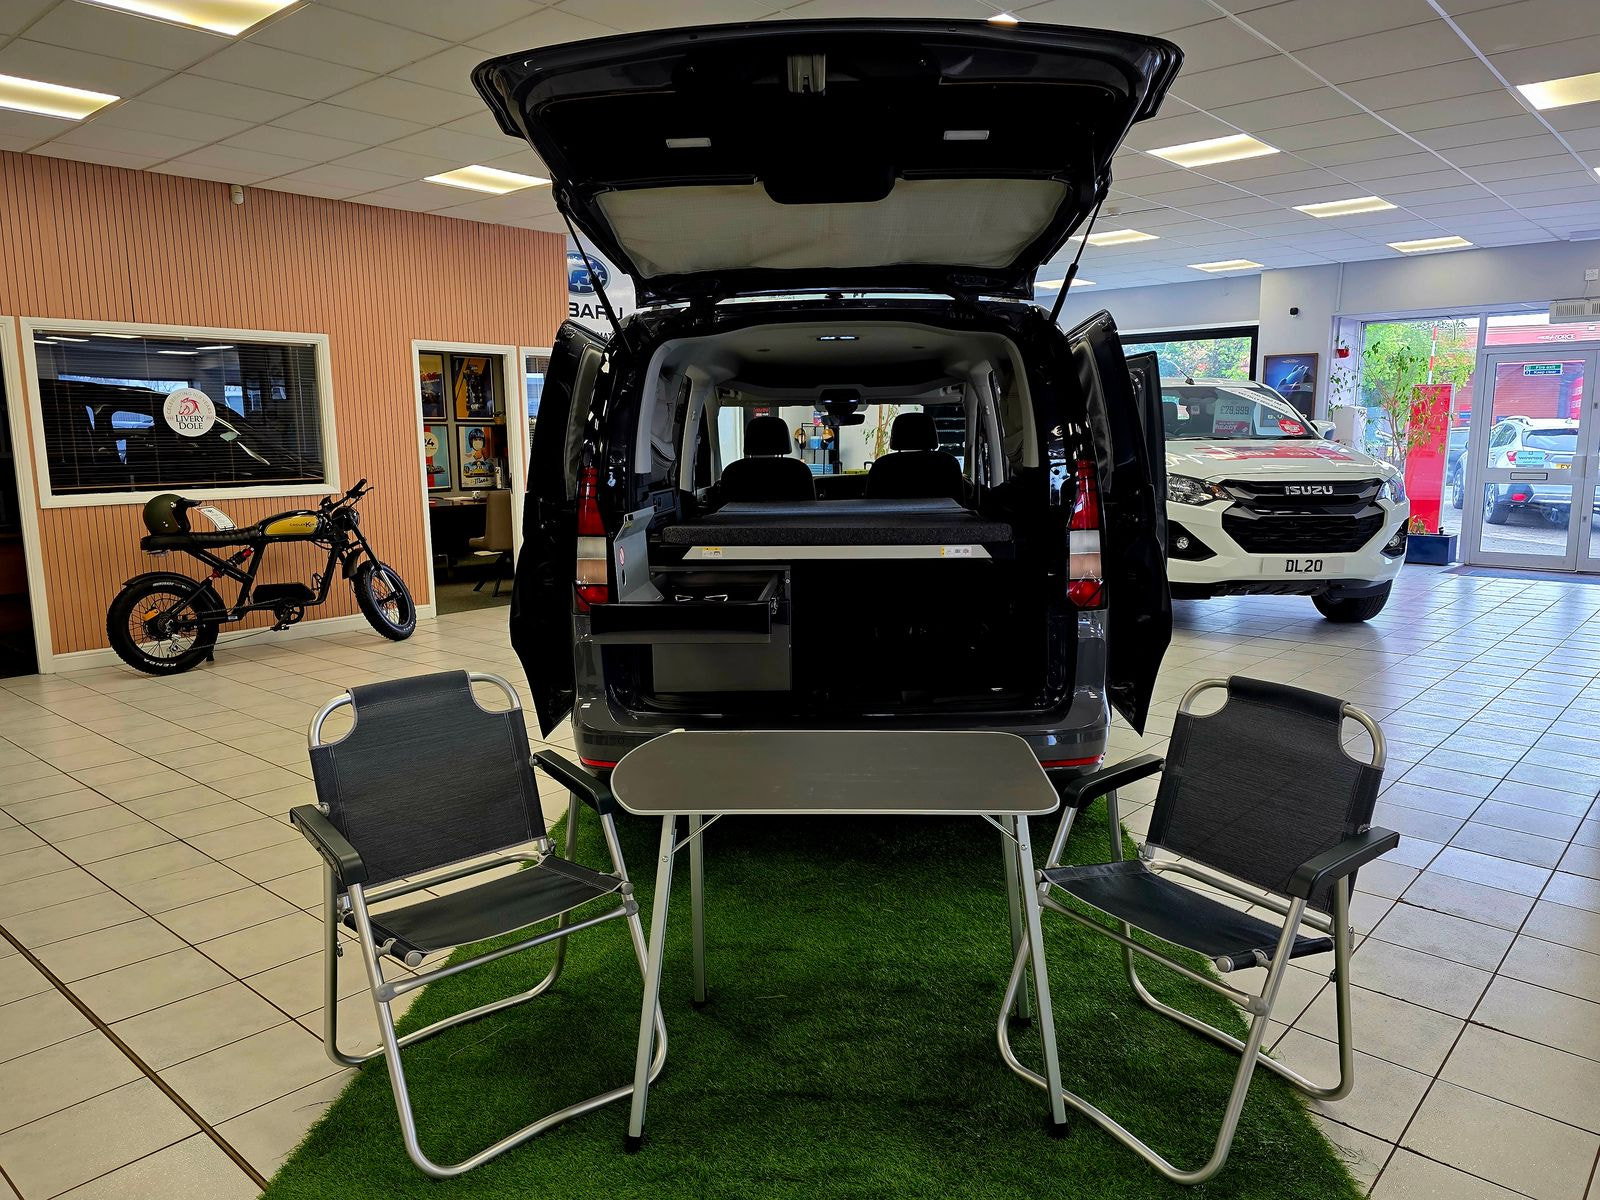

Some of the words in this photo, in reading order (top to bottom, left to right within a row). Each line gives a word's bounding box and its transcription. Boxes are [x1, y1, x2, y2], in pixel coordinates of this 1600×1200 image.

[179, 422, 204, 430] DOLE
[1284, 485, 1334, 495] ISUZU
[1284, 559, 1323, 573] DL20
[143, 658, 177, 667] KENDA
